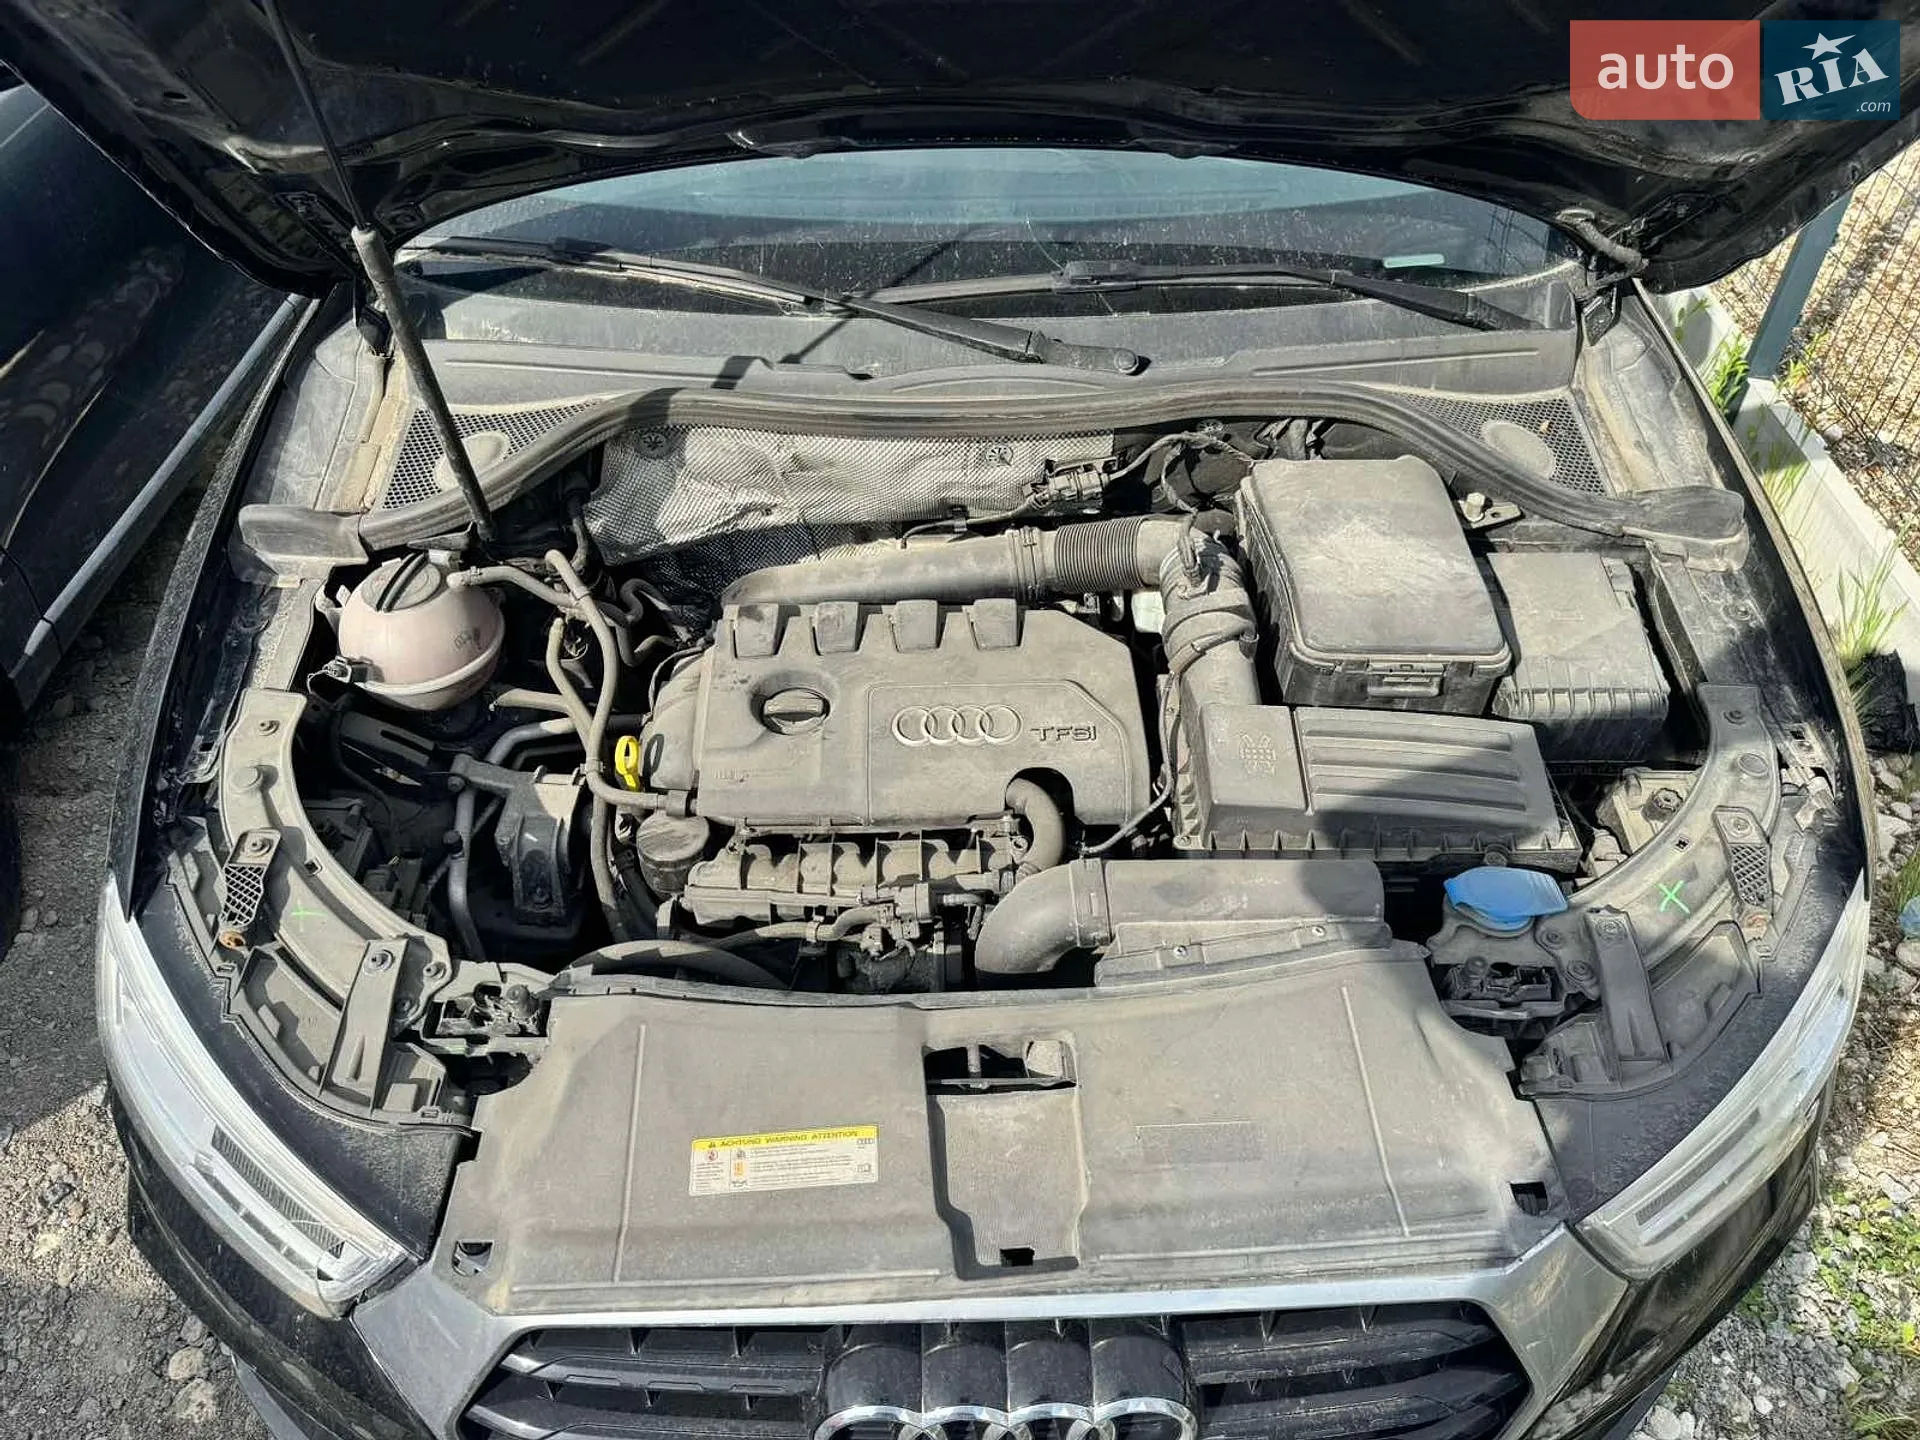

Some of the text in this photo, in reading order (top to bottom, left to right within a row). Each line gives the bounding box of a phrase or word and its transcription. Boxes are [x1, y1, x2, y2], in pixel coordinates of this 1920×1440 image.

[1030, 725, 1097, 742] TFSI
[766, 1134, 808, 1144] WARNING
[811, 1130, 858, 1141] ATTENTION
